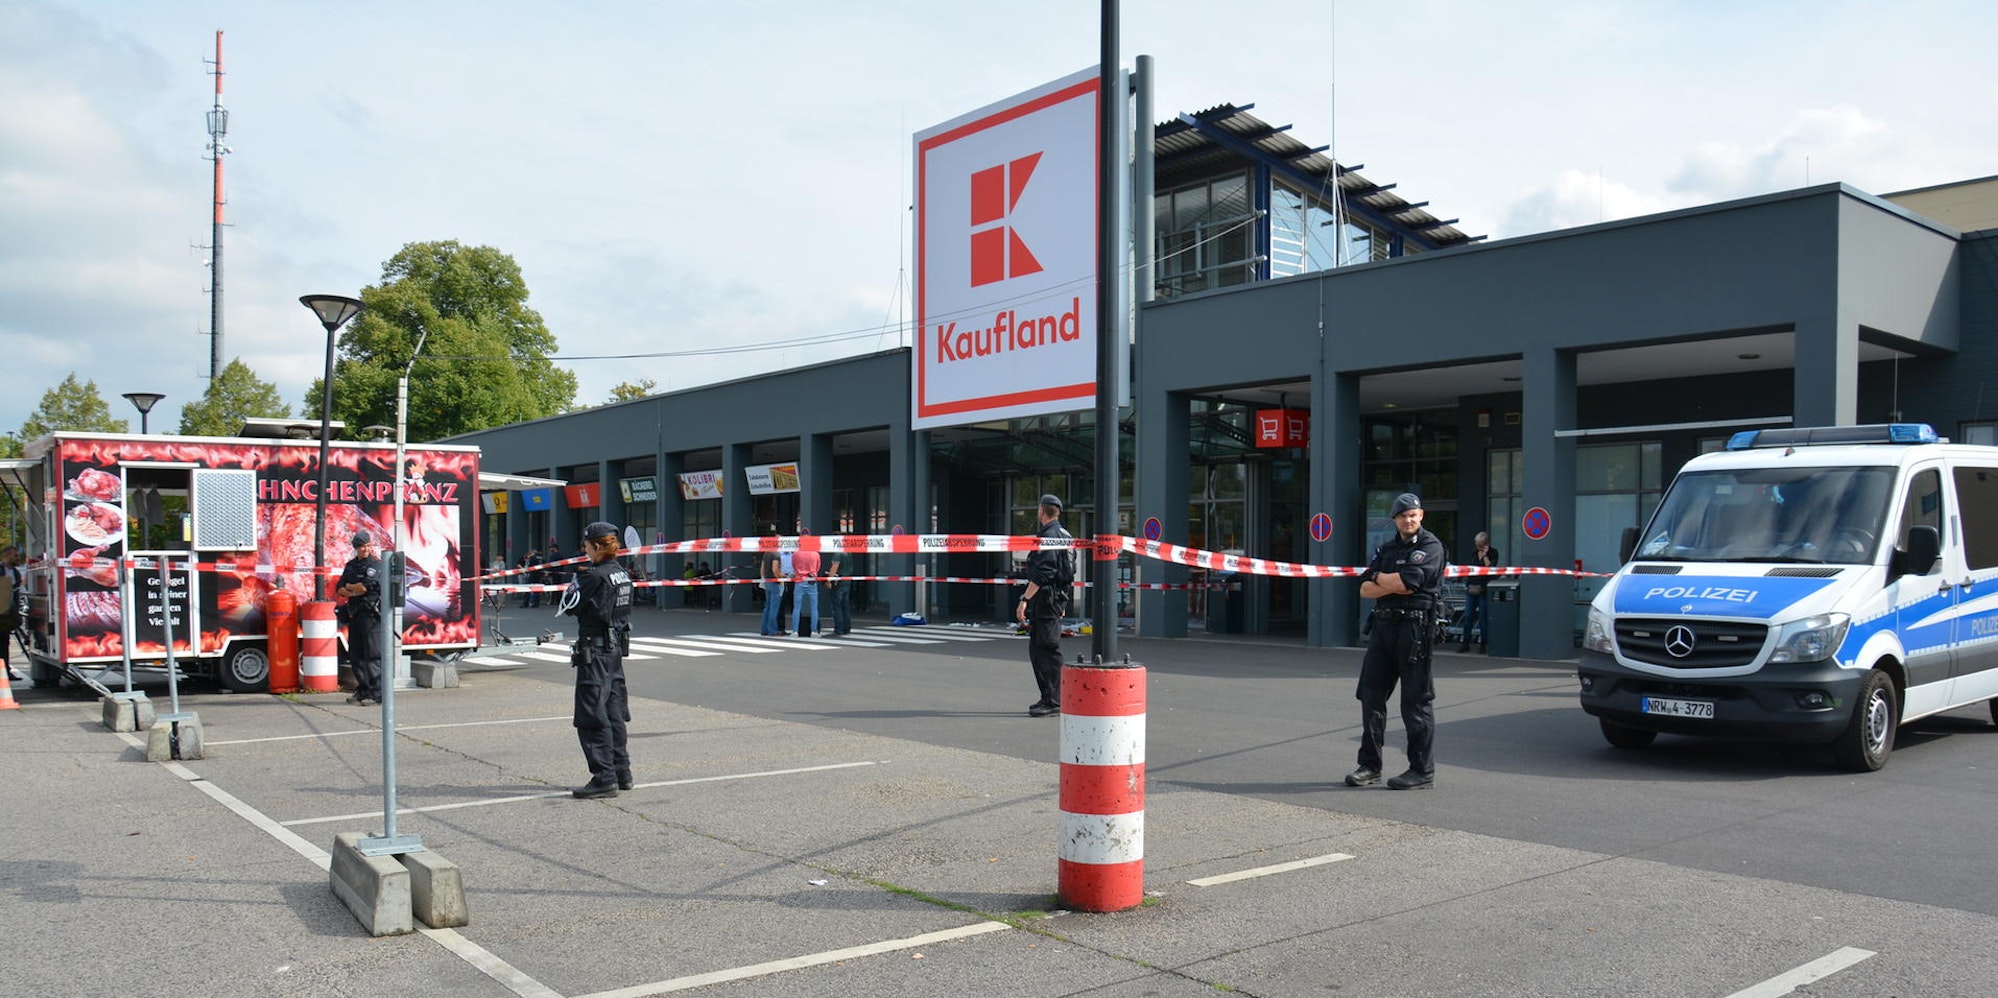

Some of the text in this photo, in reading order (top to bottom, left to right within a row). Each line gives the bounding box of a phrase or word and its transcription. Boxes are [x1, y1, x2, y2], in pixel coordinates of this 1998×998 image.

[938, 297, 1080, 363] Kaufland
[687, 474, 716, 485] KOLIBRI
[832, 538, 885, 548] POLIZEIABSPERRUNG
[923, 538, 986, 547] POLIZEIABSPERRUNG
[147, 590, 158, 599] in
[1643, 587, 1759, 603] POLIZEI
[1648, 700, 1667, 713] NRW
